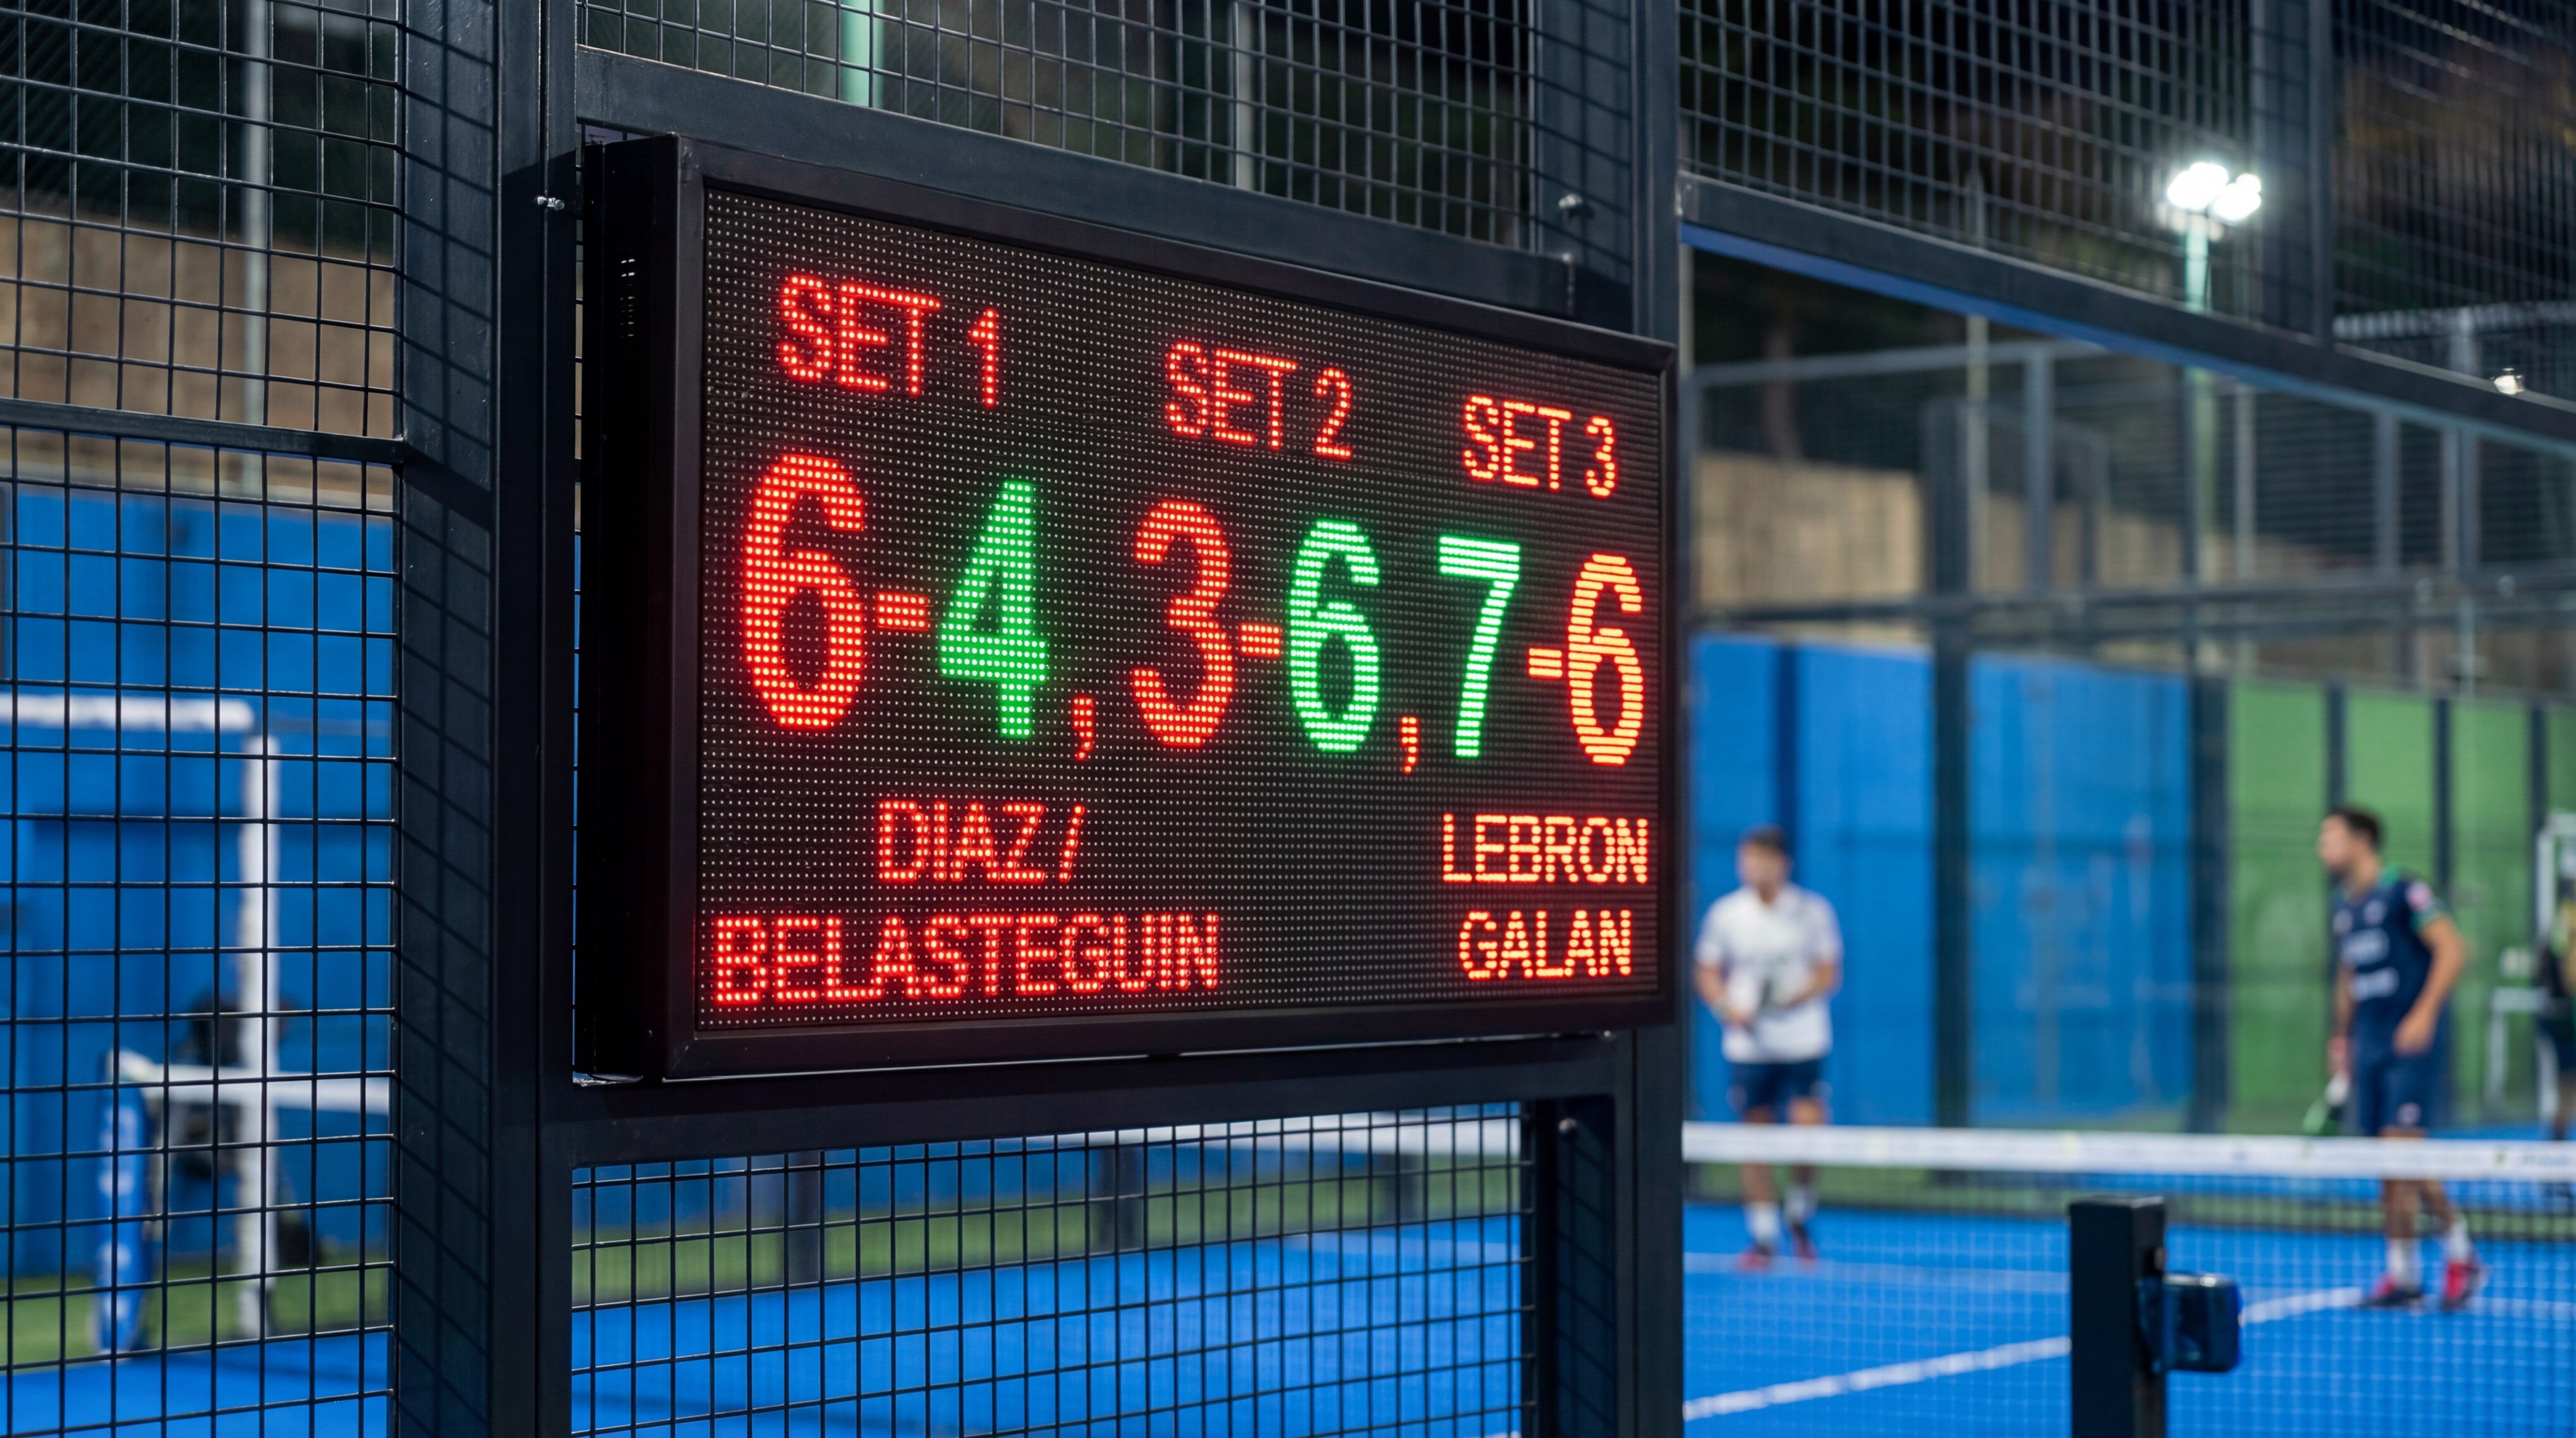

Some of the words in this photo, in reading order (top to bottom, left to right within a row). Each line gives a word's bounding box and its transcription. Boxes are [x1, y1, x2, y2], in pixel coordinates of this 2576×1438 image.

[777, 273, 942, 396] SET
[967, 307, 1000, 408] 1
[1164, 340, 1297, 451] SET
[1314, 367, 1353, 460] 2
[1461, 393, 1574, 493] SET
[1584, 414, 1619, 499] 3
[876, 798, 1048, 884] DIAZ
[1441, 811, 1650, 886] LEBRON
[713, 911, 1221, 1006] BELASTEGUIN
[1457, 908, 1633, 982] GALAN
